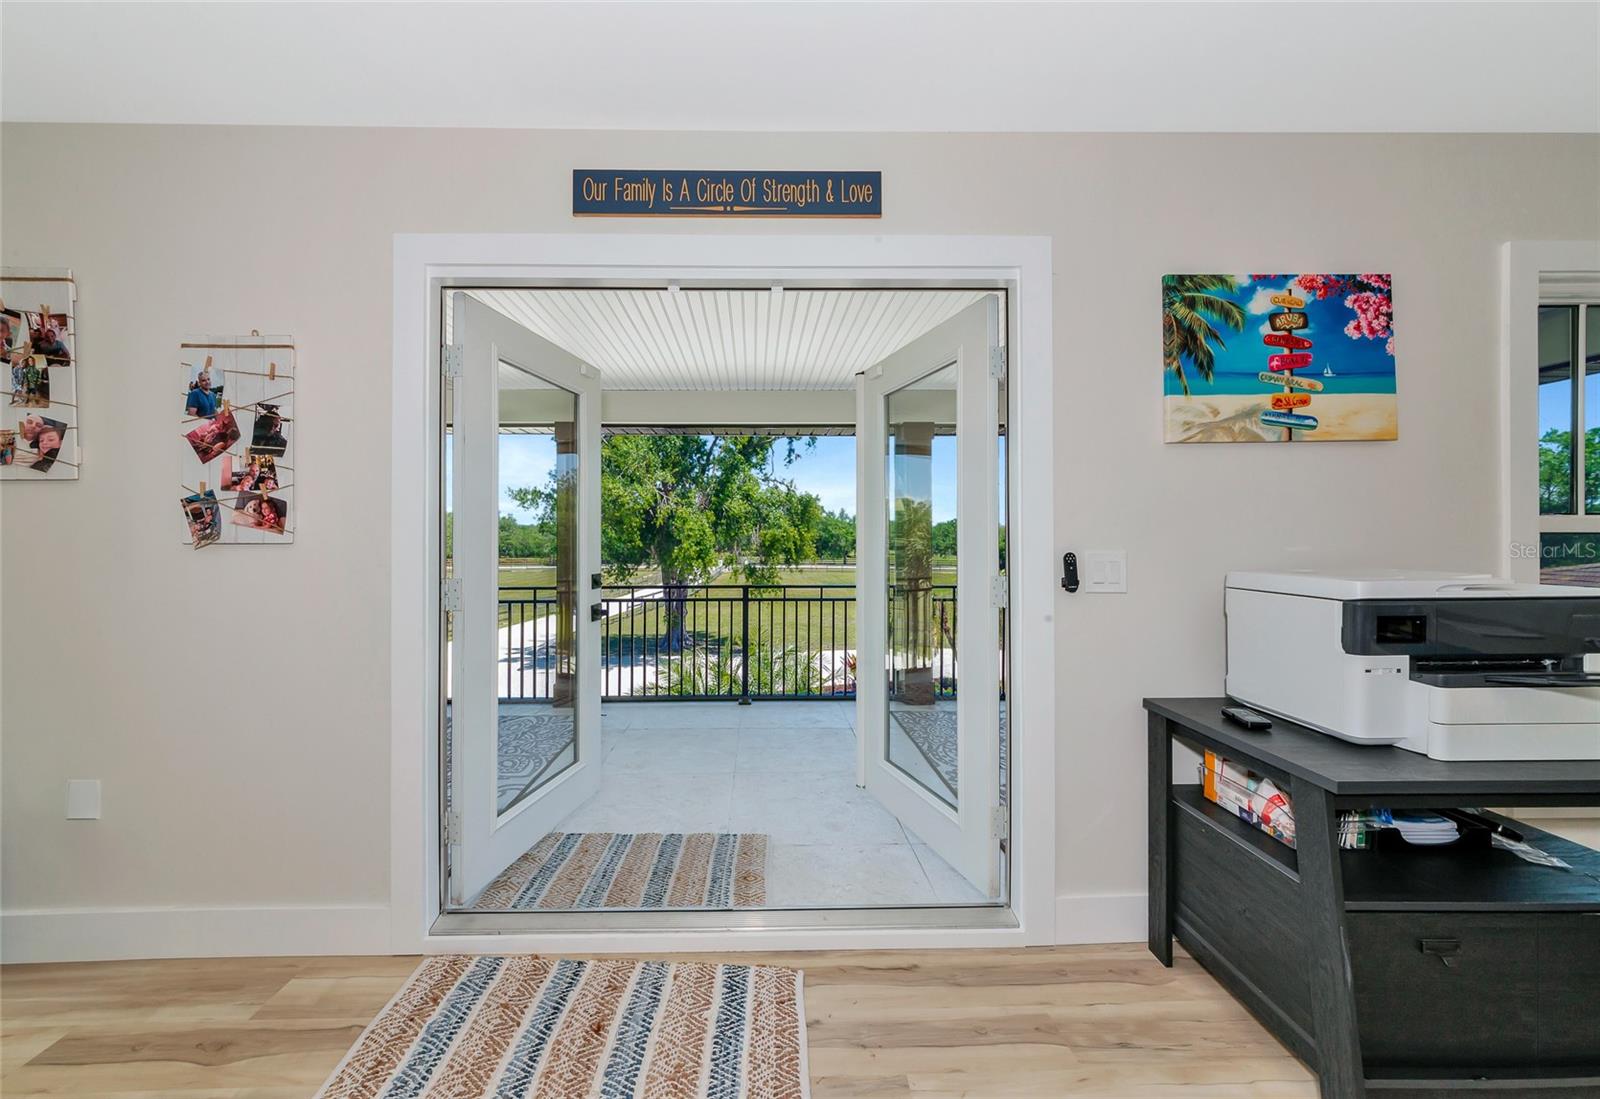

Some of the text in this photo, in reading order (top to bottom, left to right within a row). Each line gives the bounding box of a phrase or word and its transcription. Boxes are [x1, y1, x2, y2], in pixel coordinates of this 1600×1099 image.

[583, 177, 873, 208] Our Family Is A Circle Of Strength & Love
[1276, 313, 1304, 327] ARUBA
